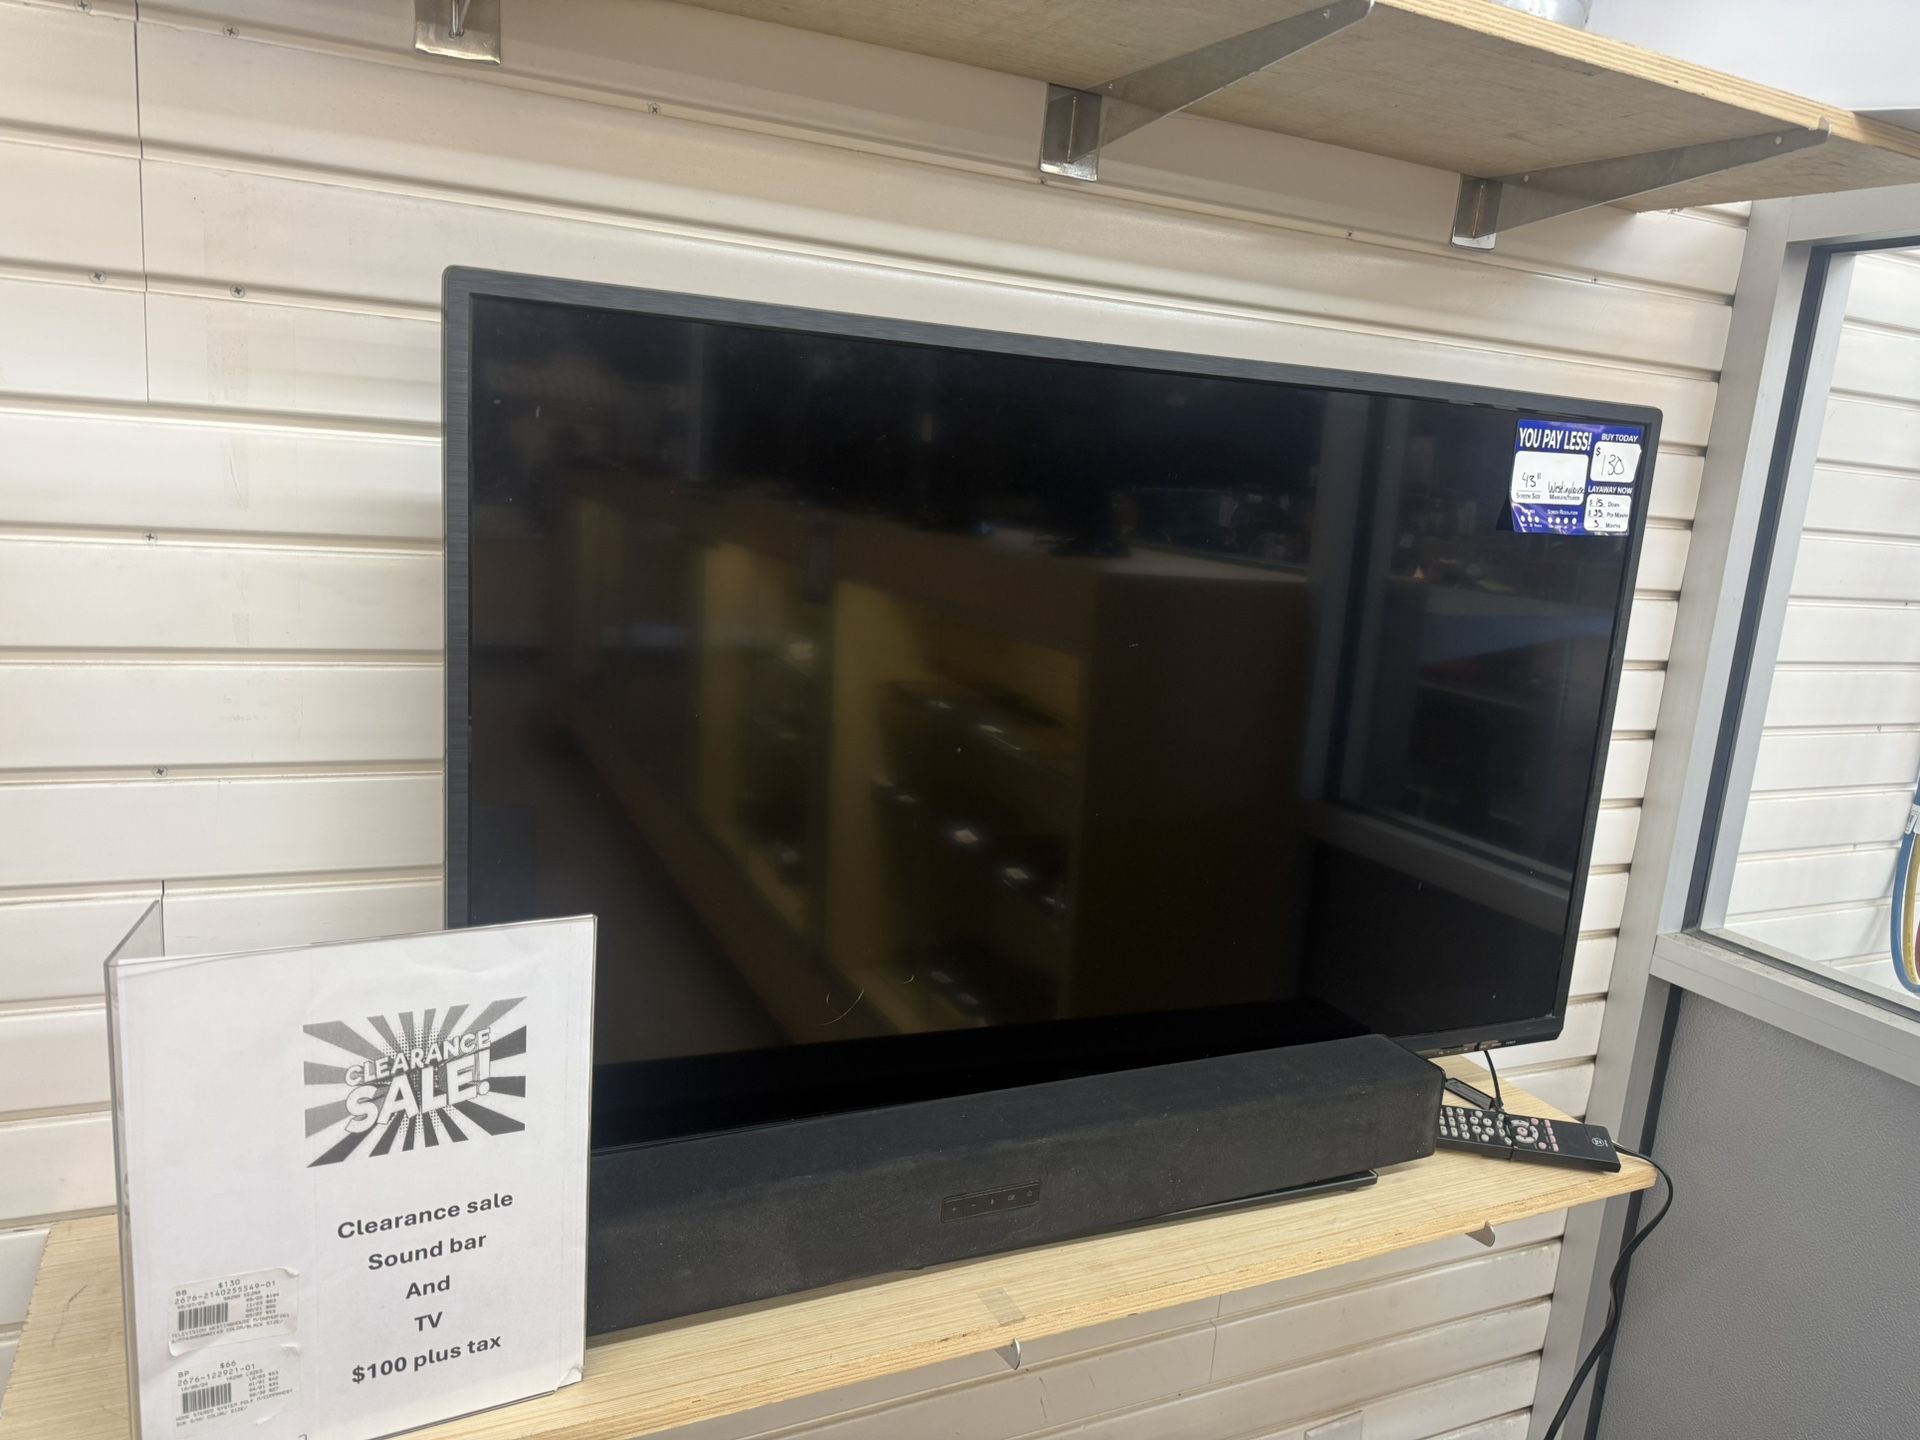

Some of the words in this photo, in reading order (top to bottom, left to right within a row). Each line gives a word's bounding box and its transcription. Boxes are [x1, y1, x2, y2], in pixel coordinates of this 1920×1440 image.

[1519, 427, 1542, 448] YOU
[1542, 429, 1564, 449] PAY
[1563, 431, 1592, 451] LESS!
[1601, 433, 1615, 441] BUY
[1615, 434, 1639, 443] TODAY
[1595, 446, 1601, 457] $
[1601, 453, 1625, 476] 130
[1587, 485, 1616, 494] LAYAWAY
[1616, 486, 1633, 495] NOW
[345, 1026, 492, 1087] CLEARANCE
[344, 1048, 492, 1134] SALE!
[337, 1204, 461, 1239] Clearance
[466, 1192, 514, 1214] sale
[368, 1240, 444, 1270] Sound
[449, 1234, 487, 1254] bar
[217, 1278, 241, 1289] $130
[405, 1275, 451, 1299] And
[414, 1311, 443, 1332] TV
[219, 1360, 237, 1369] $66
[352, 1356, 407, 1384] $100
[413, 1345, 462, 1372] plus
[467, 1335, 502, 1354] tax
[178, 1370, 190, 1378] BP
